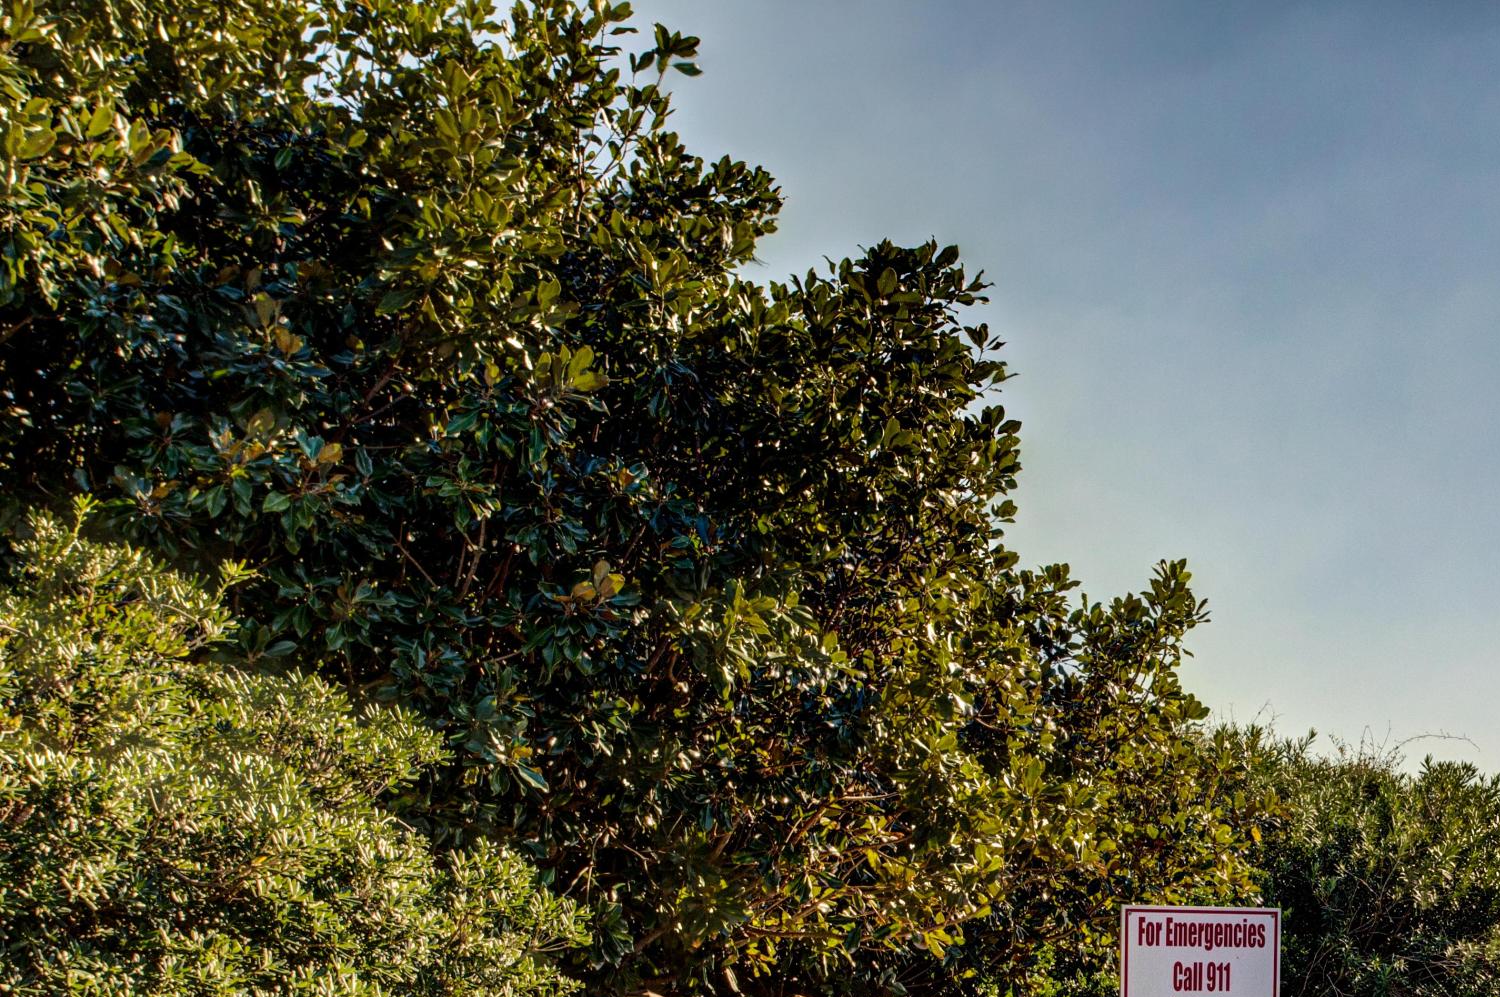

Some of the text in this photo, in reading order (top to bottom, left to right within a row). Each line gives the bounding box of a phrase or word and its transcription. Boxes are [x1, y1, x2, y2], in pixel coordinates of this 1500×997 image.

[1138, 917, 1265, 950] For Emergencies
[1173, 961, 1230, 991] Call 911
